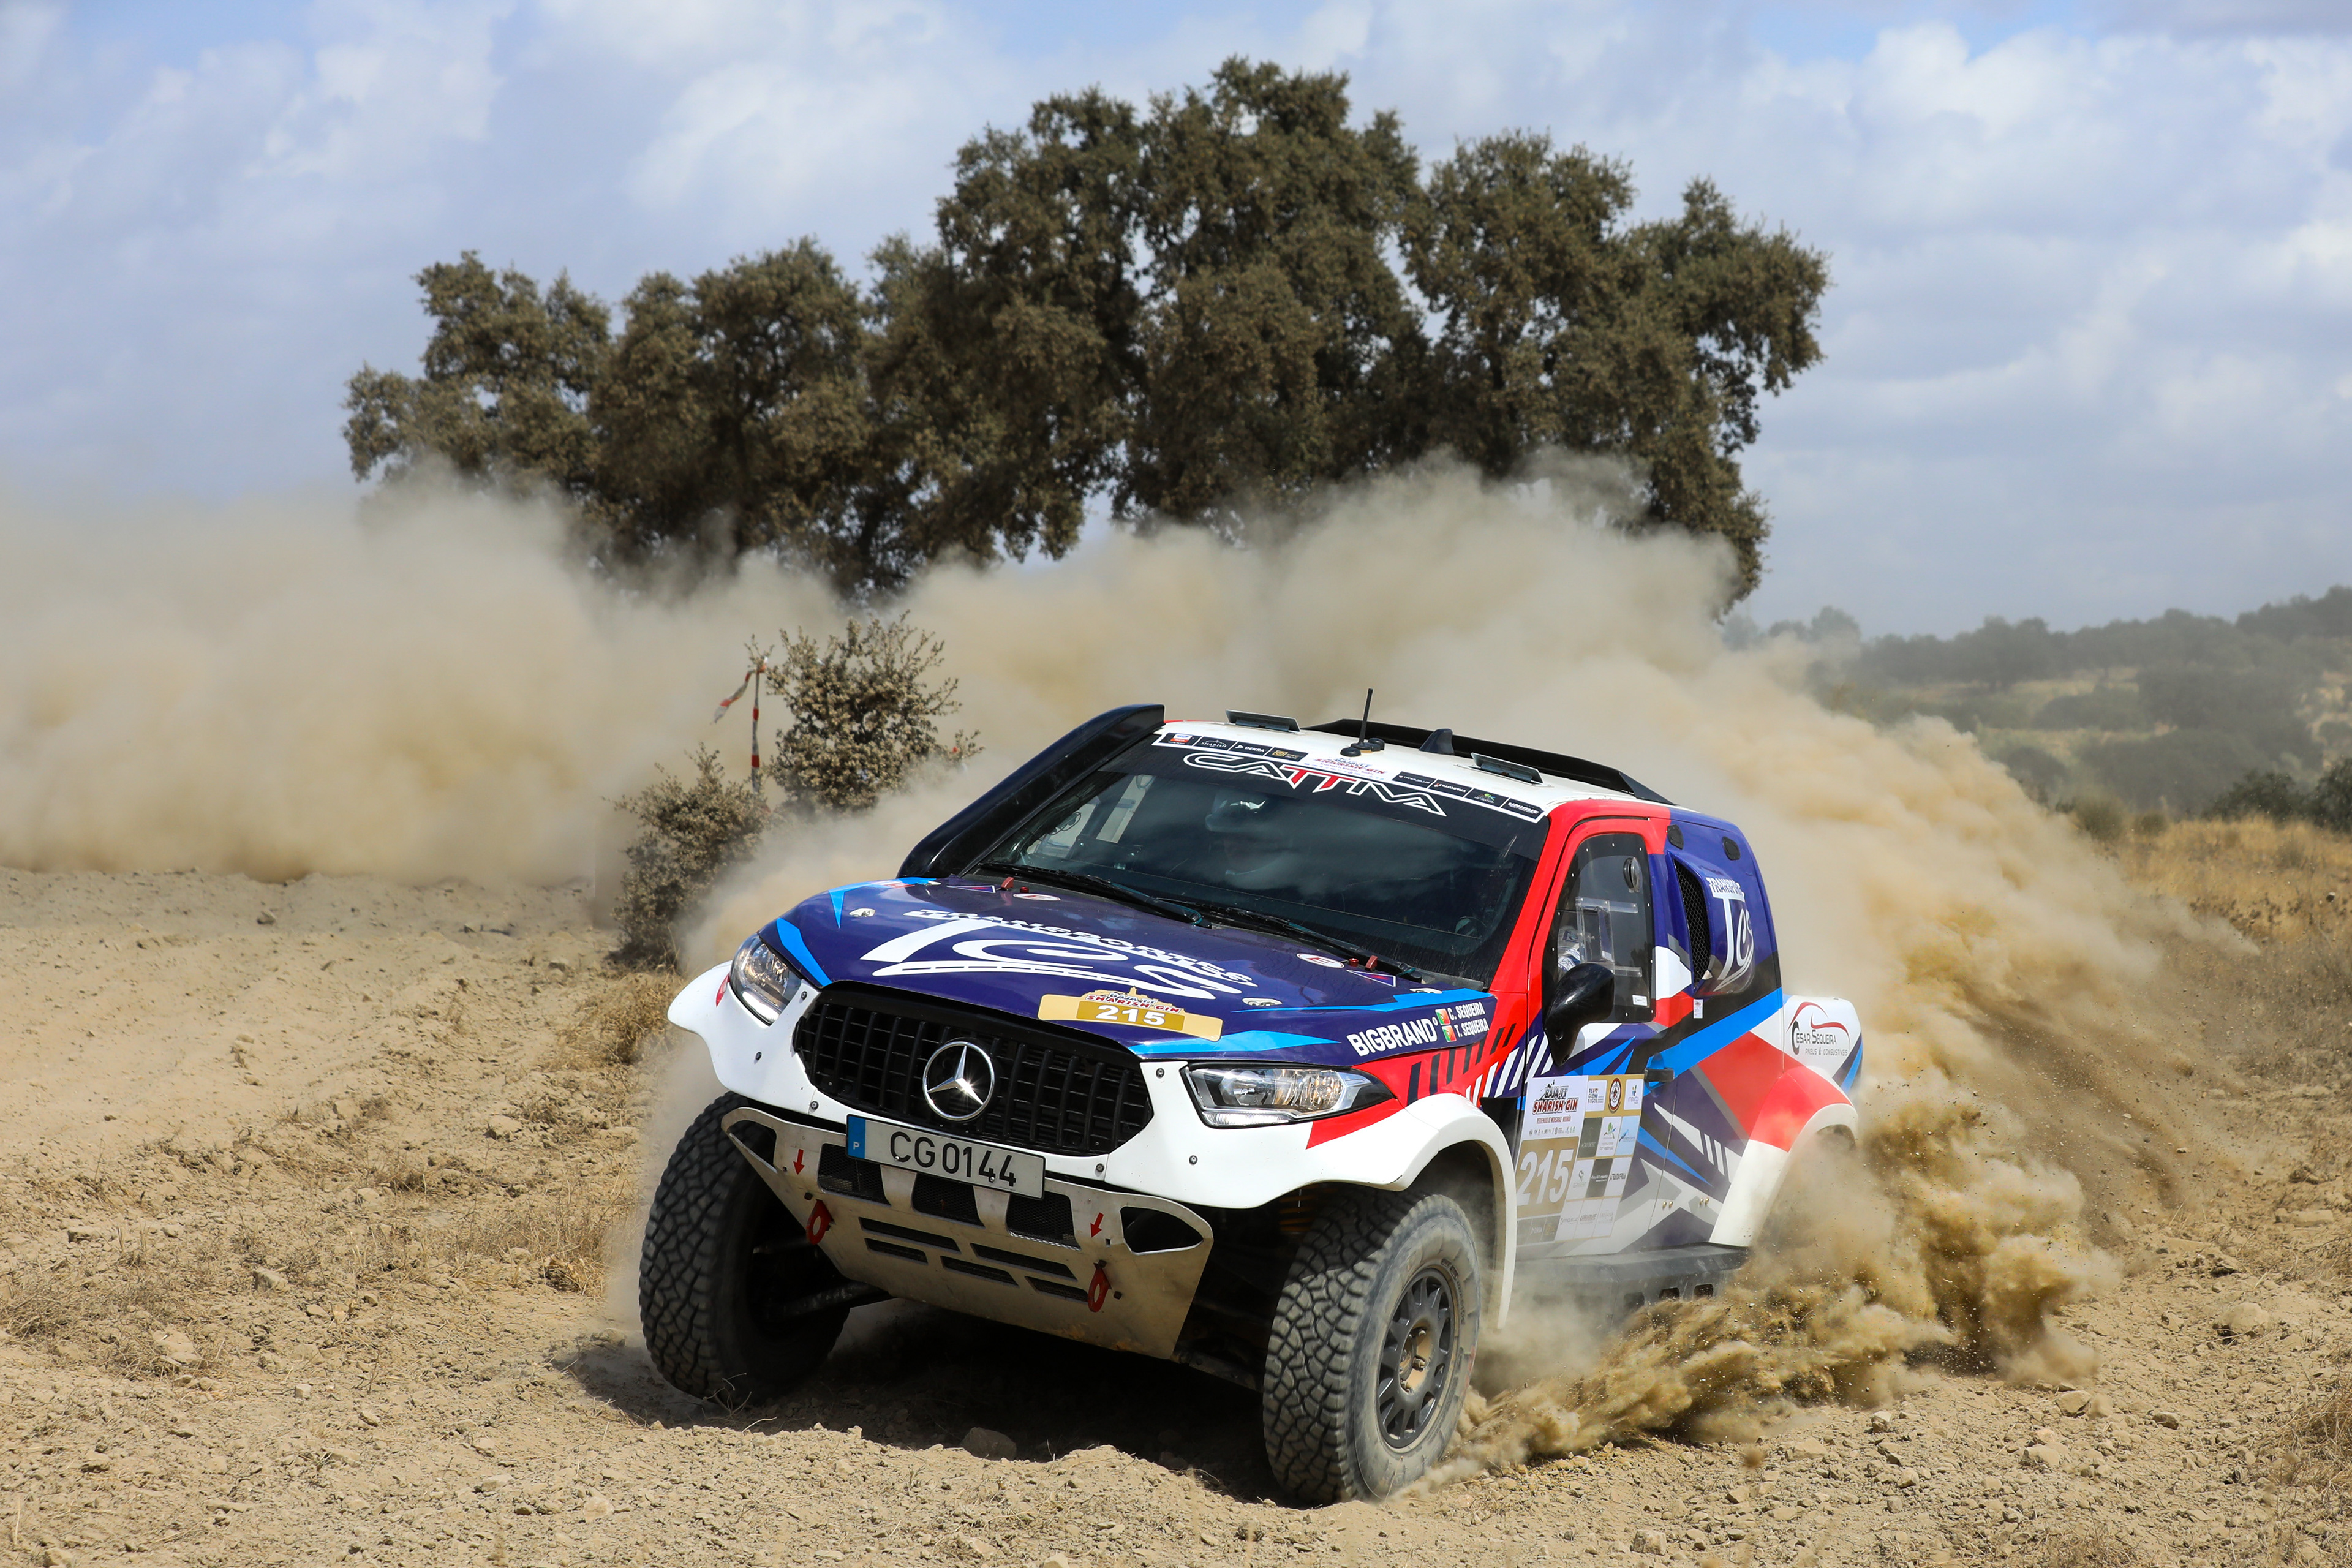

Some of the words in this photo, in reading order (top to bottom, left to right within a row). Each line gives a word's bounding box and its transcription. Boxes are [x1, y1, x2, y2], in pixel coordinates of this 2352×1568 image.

[1183, 752, 1447, 816] CATTIVA
[903, 909, 1258, 987] TRANSPORTES
[1087, 994, 1151, 1008] SHARISH
[1154, 1005, 1182, 1013] GIN
[1110, 992, 1138, 1004] BAJA
[1095, 1005, 1166, 1025] 215
[1448, 1008, 1457, 1021] C.
[1457, 1001, 1485, 1019] SEQUEIRA
[1454, 1025, 1462, 1038] T.
[1461, 1018, 1490, 1036] SEQUEIRA
[1811, 1029, 1837, 1044] SEQUEIRA
[1545, 1087, 1559, 1099] BAJA
[1532, 1099, 1564, 1114] SHARISH
[1565, 1098, 1579, 1112] GIN
[1517, 1148, 1574, 1207] 215
